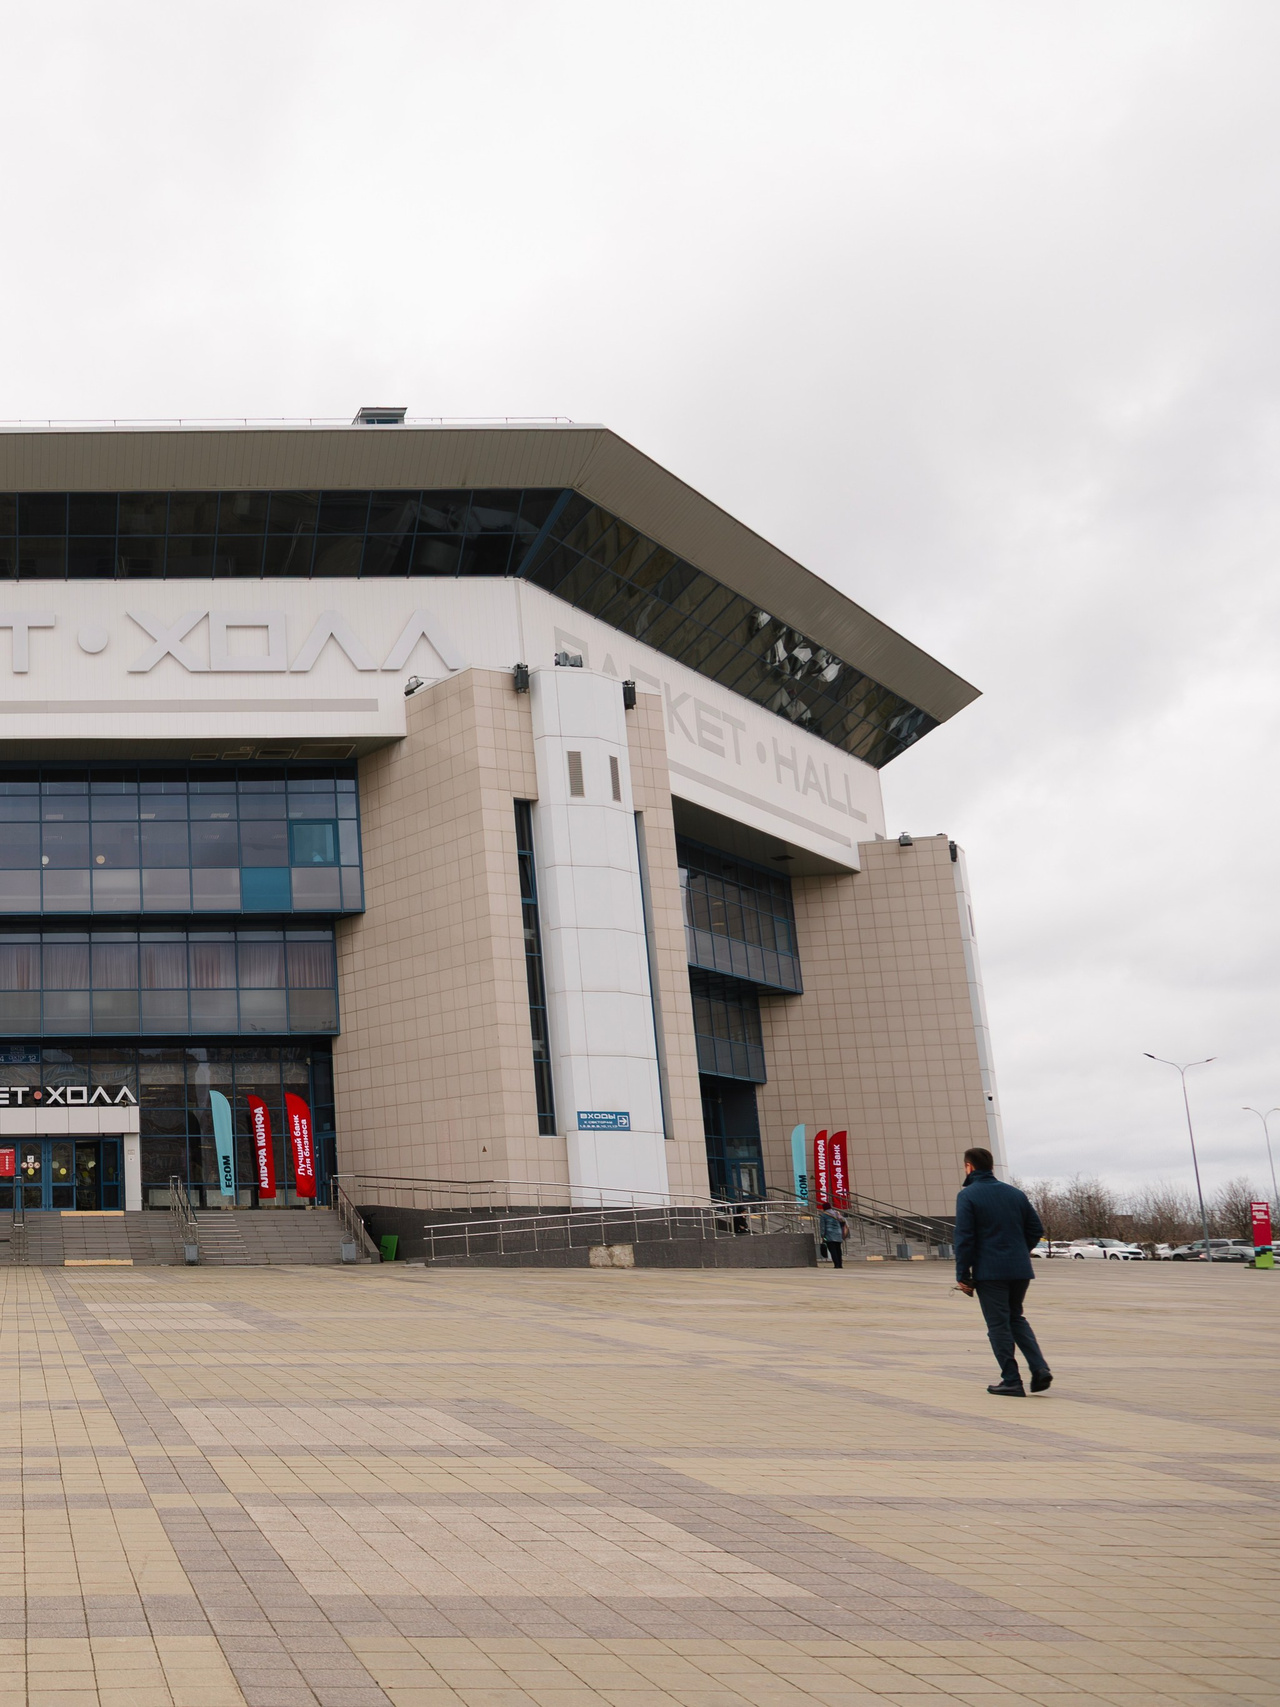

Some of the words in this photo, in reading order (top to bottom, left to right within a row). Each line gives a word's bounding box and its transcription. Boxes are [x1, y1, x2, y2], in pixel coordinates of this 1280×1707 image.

[125, 609, 466, 673] ХОЛЛ
[773, 737, 868, 824] HALL
[45, 1086, 137, 1104] ХОЛЛ
[254, 1106, 266, 1147] КОНФА
[292, 1114, 301, 1137] банк
[301, 1118, 311, 1157] бизнеса
[222, 1155, 233, 1188] ECOM
[295, 1137, 306, 1176] Лучший
[817, 1139, 826, 1171] КОНФА
[833, 1144, 842, 1166] Банк
